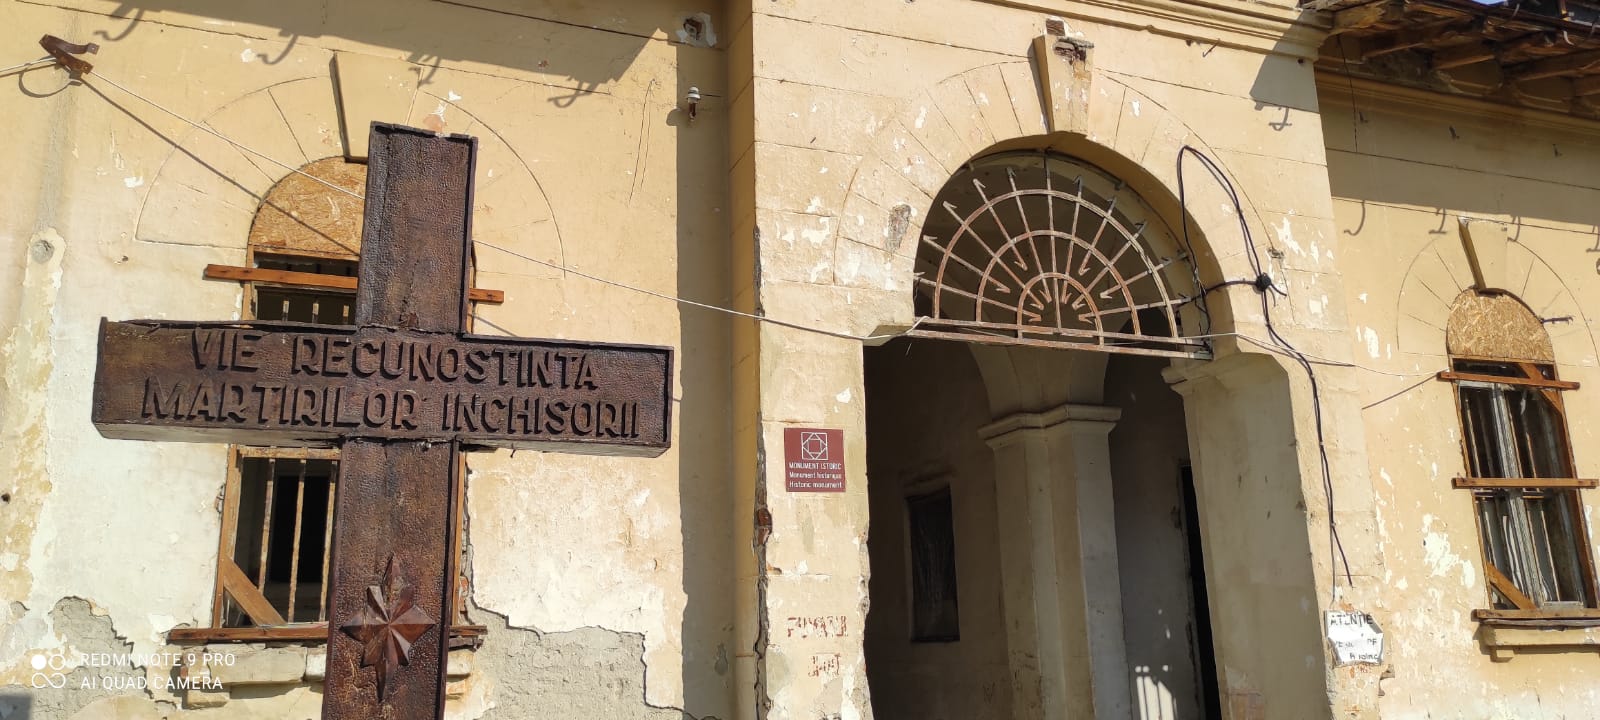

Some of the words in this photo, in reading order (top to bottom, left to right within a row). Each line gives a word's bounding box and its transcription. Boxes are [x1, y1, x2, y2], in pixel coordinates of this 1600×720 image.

[191, 328, 263, 374] VIE
[291, 336, 599, 390] RECUNOSTINTA
[140, 374, 418, 431] MARTIRILOR
[441, 391, 640, 439] INCHISORII
[788, 462, 819, 470] MONUMENT
[820, 462, 842, 470] ISTORIC
[789, 471, 816, 479] Monument
